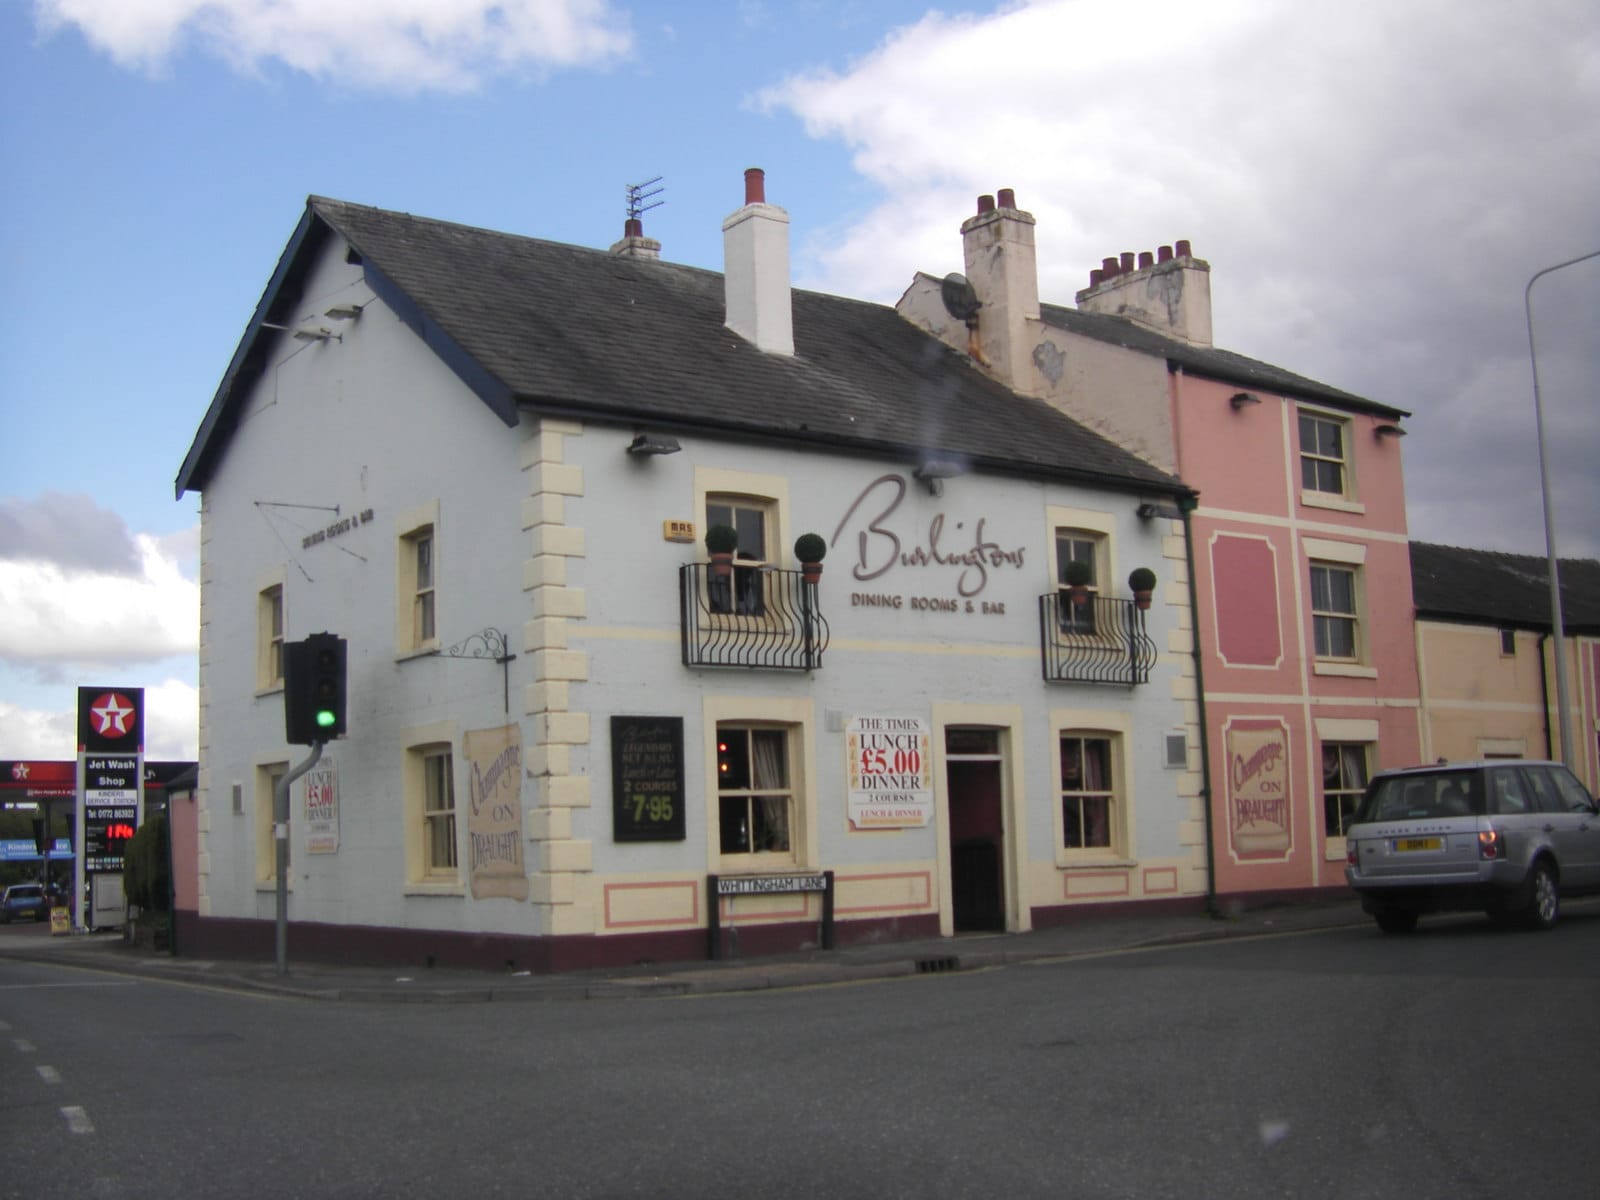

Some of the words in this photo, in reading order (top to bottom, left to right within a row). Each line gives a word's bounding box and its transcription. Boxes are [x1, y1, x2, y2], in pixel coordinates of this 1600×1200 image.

[831, 474, 1026, 597] Burlingtons
[851, 592, 902, 609] DINING
[910, 596, 958, 613] ROOMS
[965, 600, 974, 614] &
[982, 601, 1005, 616] BAR
[859, 718, 883, 730] THE
[885, 719, 919, 730] TIMES
[860, 734, 919, 750] LUNCH
[89, 760, 105, 769] Jet
[108, 760, 135, 769] Wash
[860, 748, 921, 775] £5.00
[98, 776, 125, 786] Shop
[861, 775, 921, 790] DINNER
[1260, 780, 1281, 793] ON
[492, 804, 514, 822] ON
[1235, 798, 1285, 830] DRAUGHT
[471, 830, 519, 871] DRAUGHT
[720, 880, 794, 892] WHITTINGHAM
